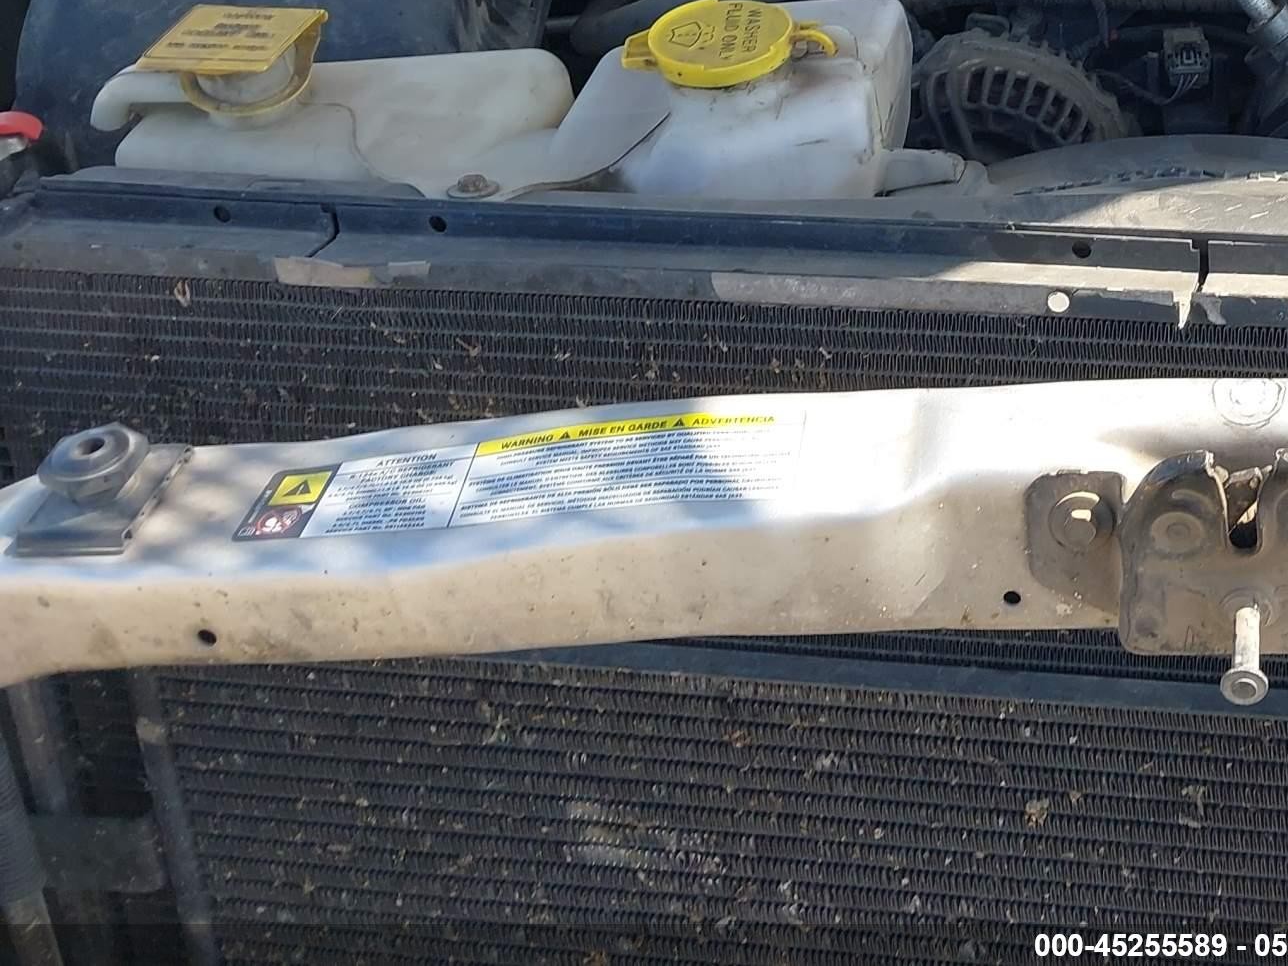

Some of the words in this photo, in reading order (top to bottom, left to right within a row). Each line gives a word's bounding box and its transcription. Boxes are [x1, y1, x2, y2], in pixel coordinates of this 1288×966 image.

[723, 2, 744, 31] FLUID
[742, 8, 763, 53] WASHER
[718, 34, 738, 60] ONLY
[501, 434, 554, 450] WARNING
[578, 426, 607, 438] MISE
[609, 424, 626, 434] EN
[627, 419, 668, 432] GARDE
[691, 415, 776, 427] ADVERTENCIA
[376, 453, 437, 467] ATTENTION
